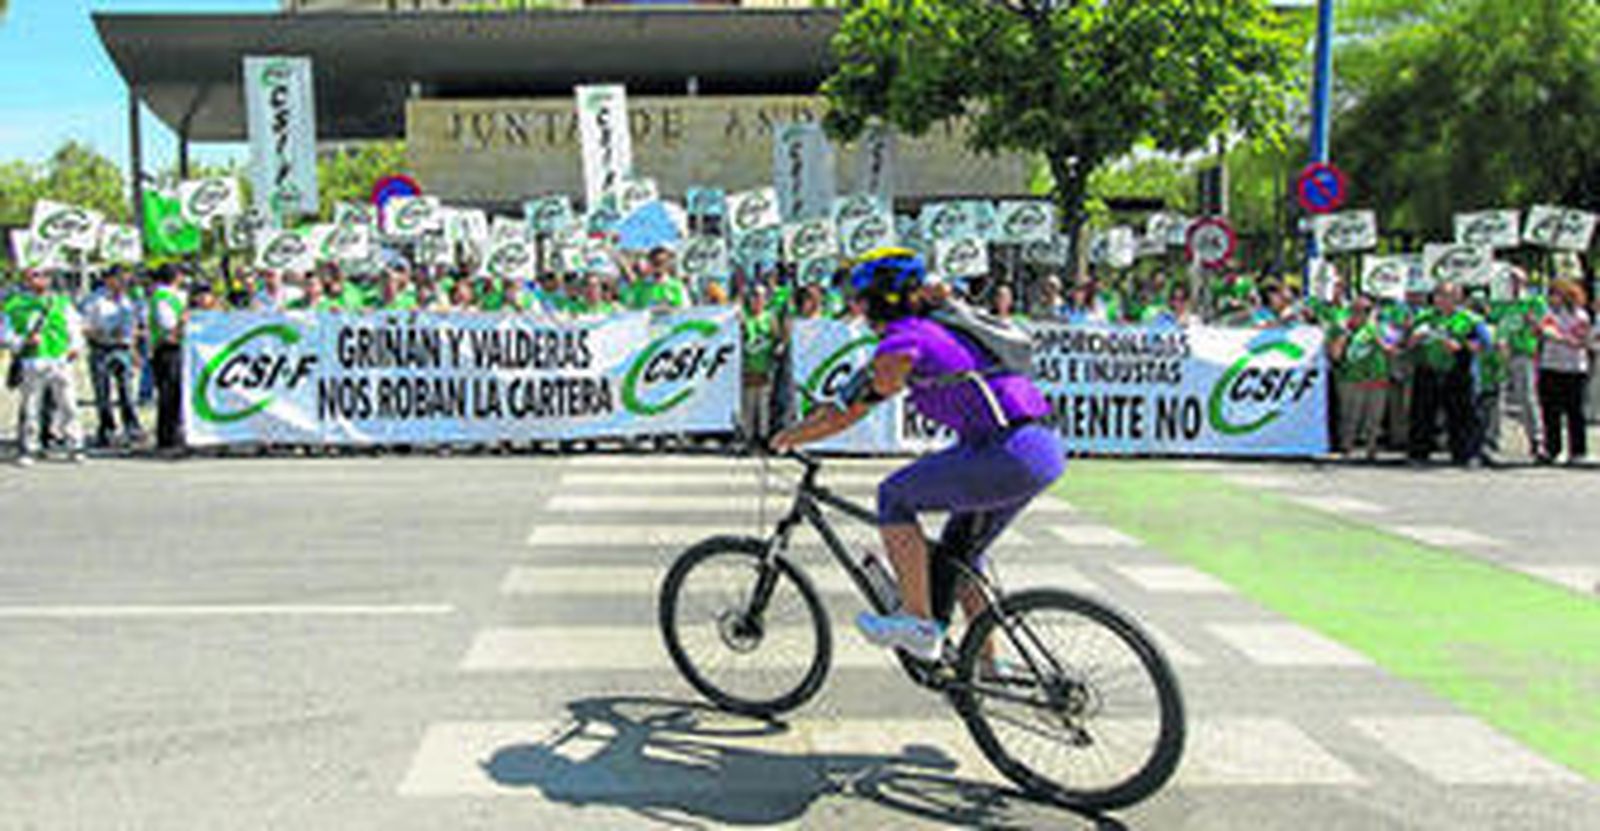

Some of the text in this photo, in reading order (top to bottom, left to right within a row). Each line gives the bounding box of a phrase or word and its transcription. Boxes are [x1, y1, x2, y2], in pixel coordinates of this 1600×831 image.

[447, 328, 464, 368] Y
[468, 328, 593, 368] VALDERAS
[1069, 358, 1078, 382] E
[1083, 358, 1182, 384] INJUSTAS
[317, 376, 614, 420] NOS ROBAN LA CARTERA
[1155, 395, 1203, 440] NO
